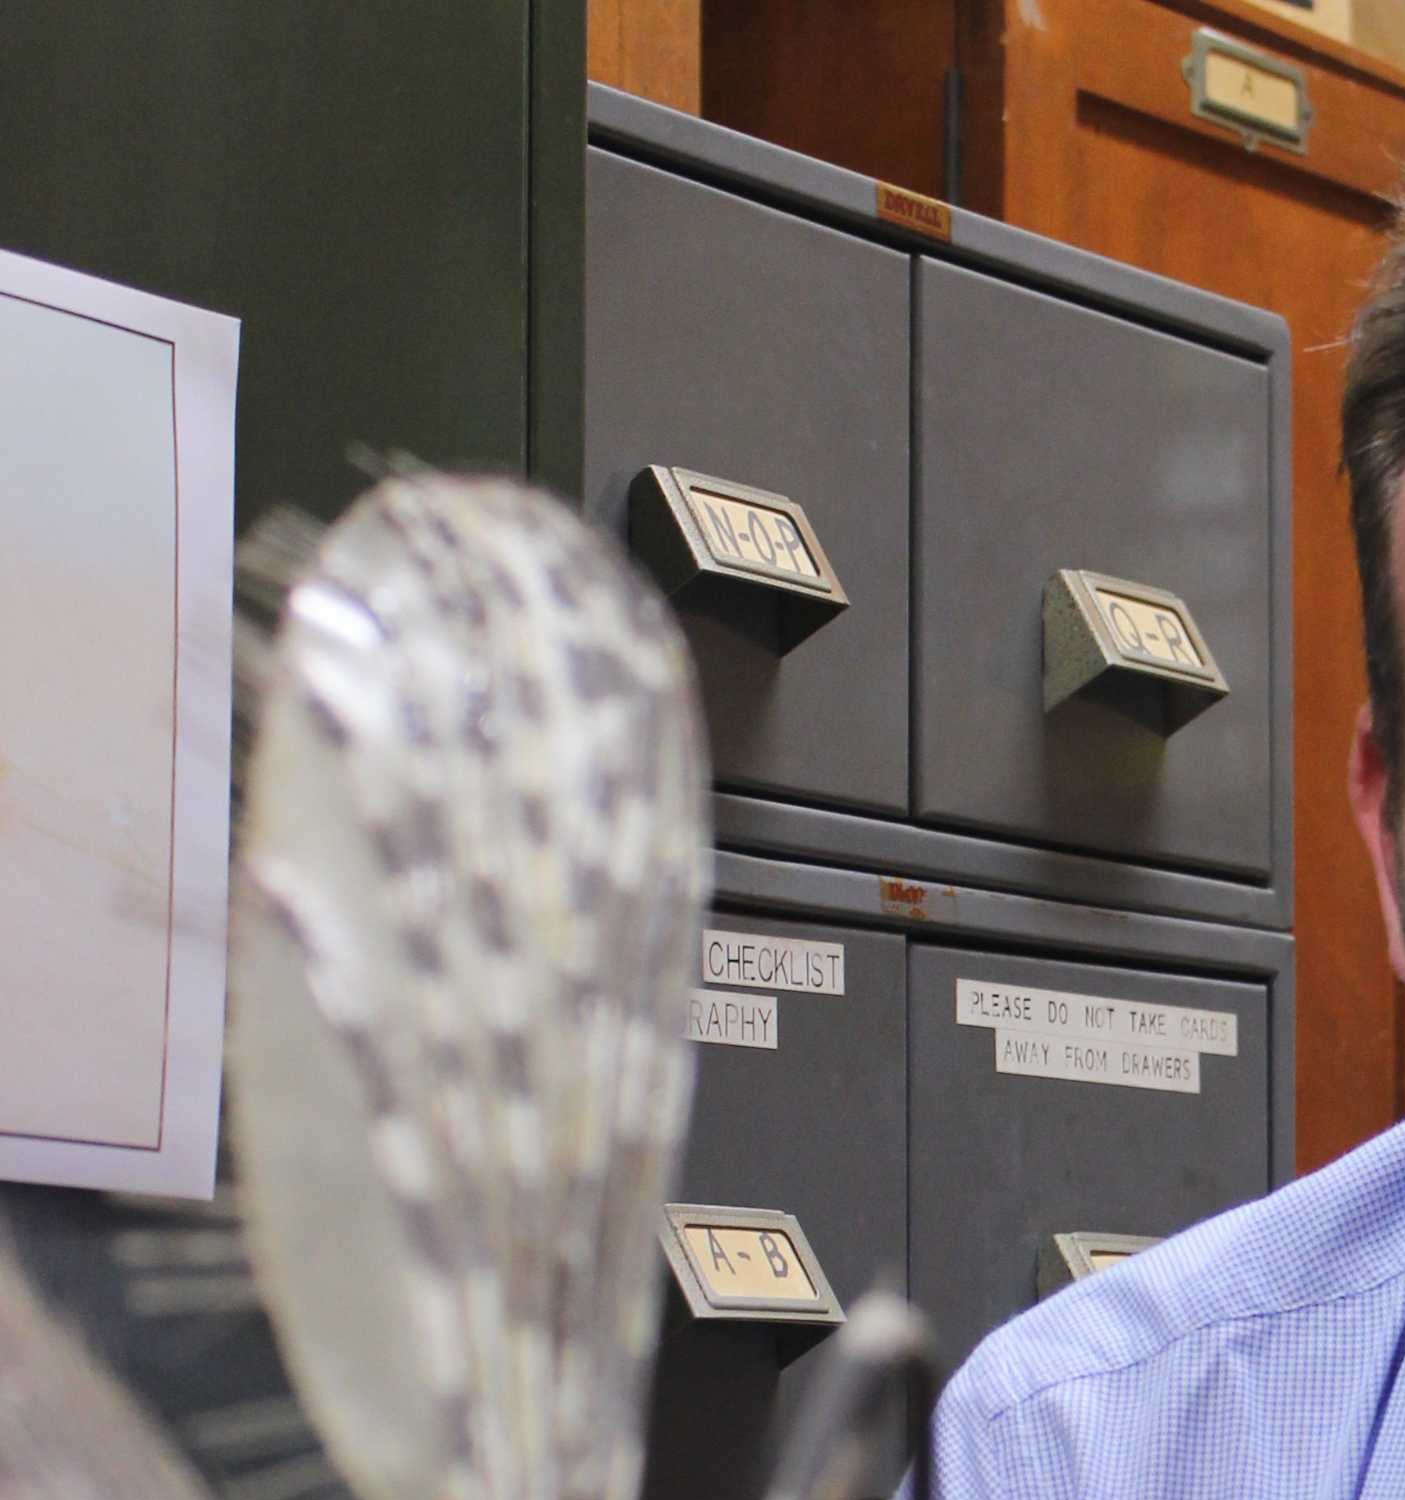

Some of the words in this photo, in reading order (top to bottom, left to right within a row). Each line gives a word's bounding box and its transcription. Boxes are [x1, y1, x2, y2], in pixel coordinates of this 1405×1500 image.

[704, 502, 802, 573] N-O-P
[1109, 602, 1195, 666] Q-R
[708, 941, 840, 989] CHECKLIST
[687, 999, 773, 1041] RAPHY
[970, 991, 1032, 1021] PLEASE
[1048, 1000, 1068, 1025] DO
[1085, 1005, 1115, 1030] NOT
[1129, 1011, 1167, 1036] TAKE
[1180, 1015, 1229, 1042] CARDS
[1003, 1039, 1050, 1065] AWAY
[1064, 1045, 1107, 1072] FROM
[1121, 1052, 1191, 1080] DRAWERS
